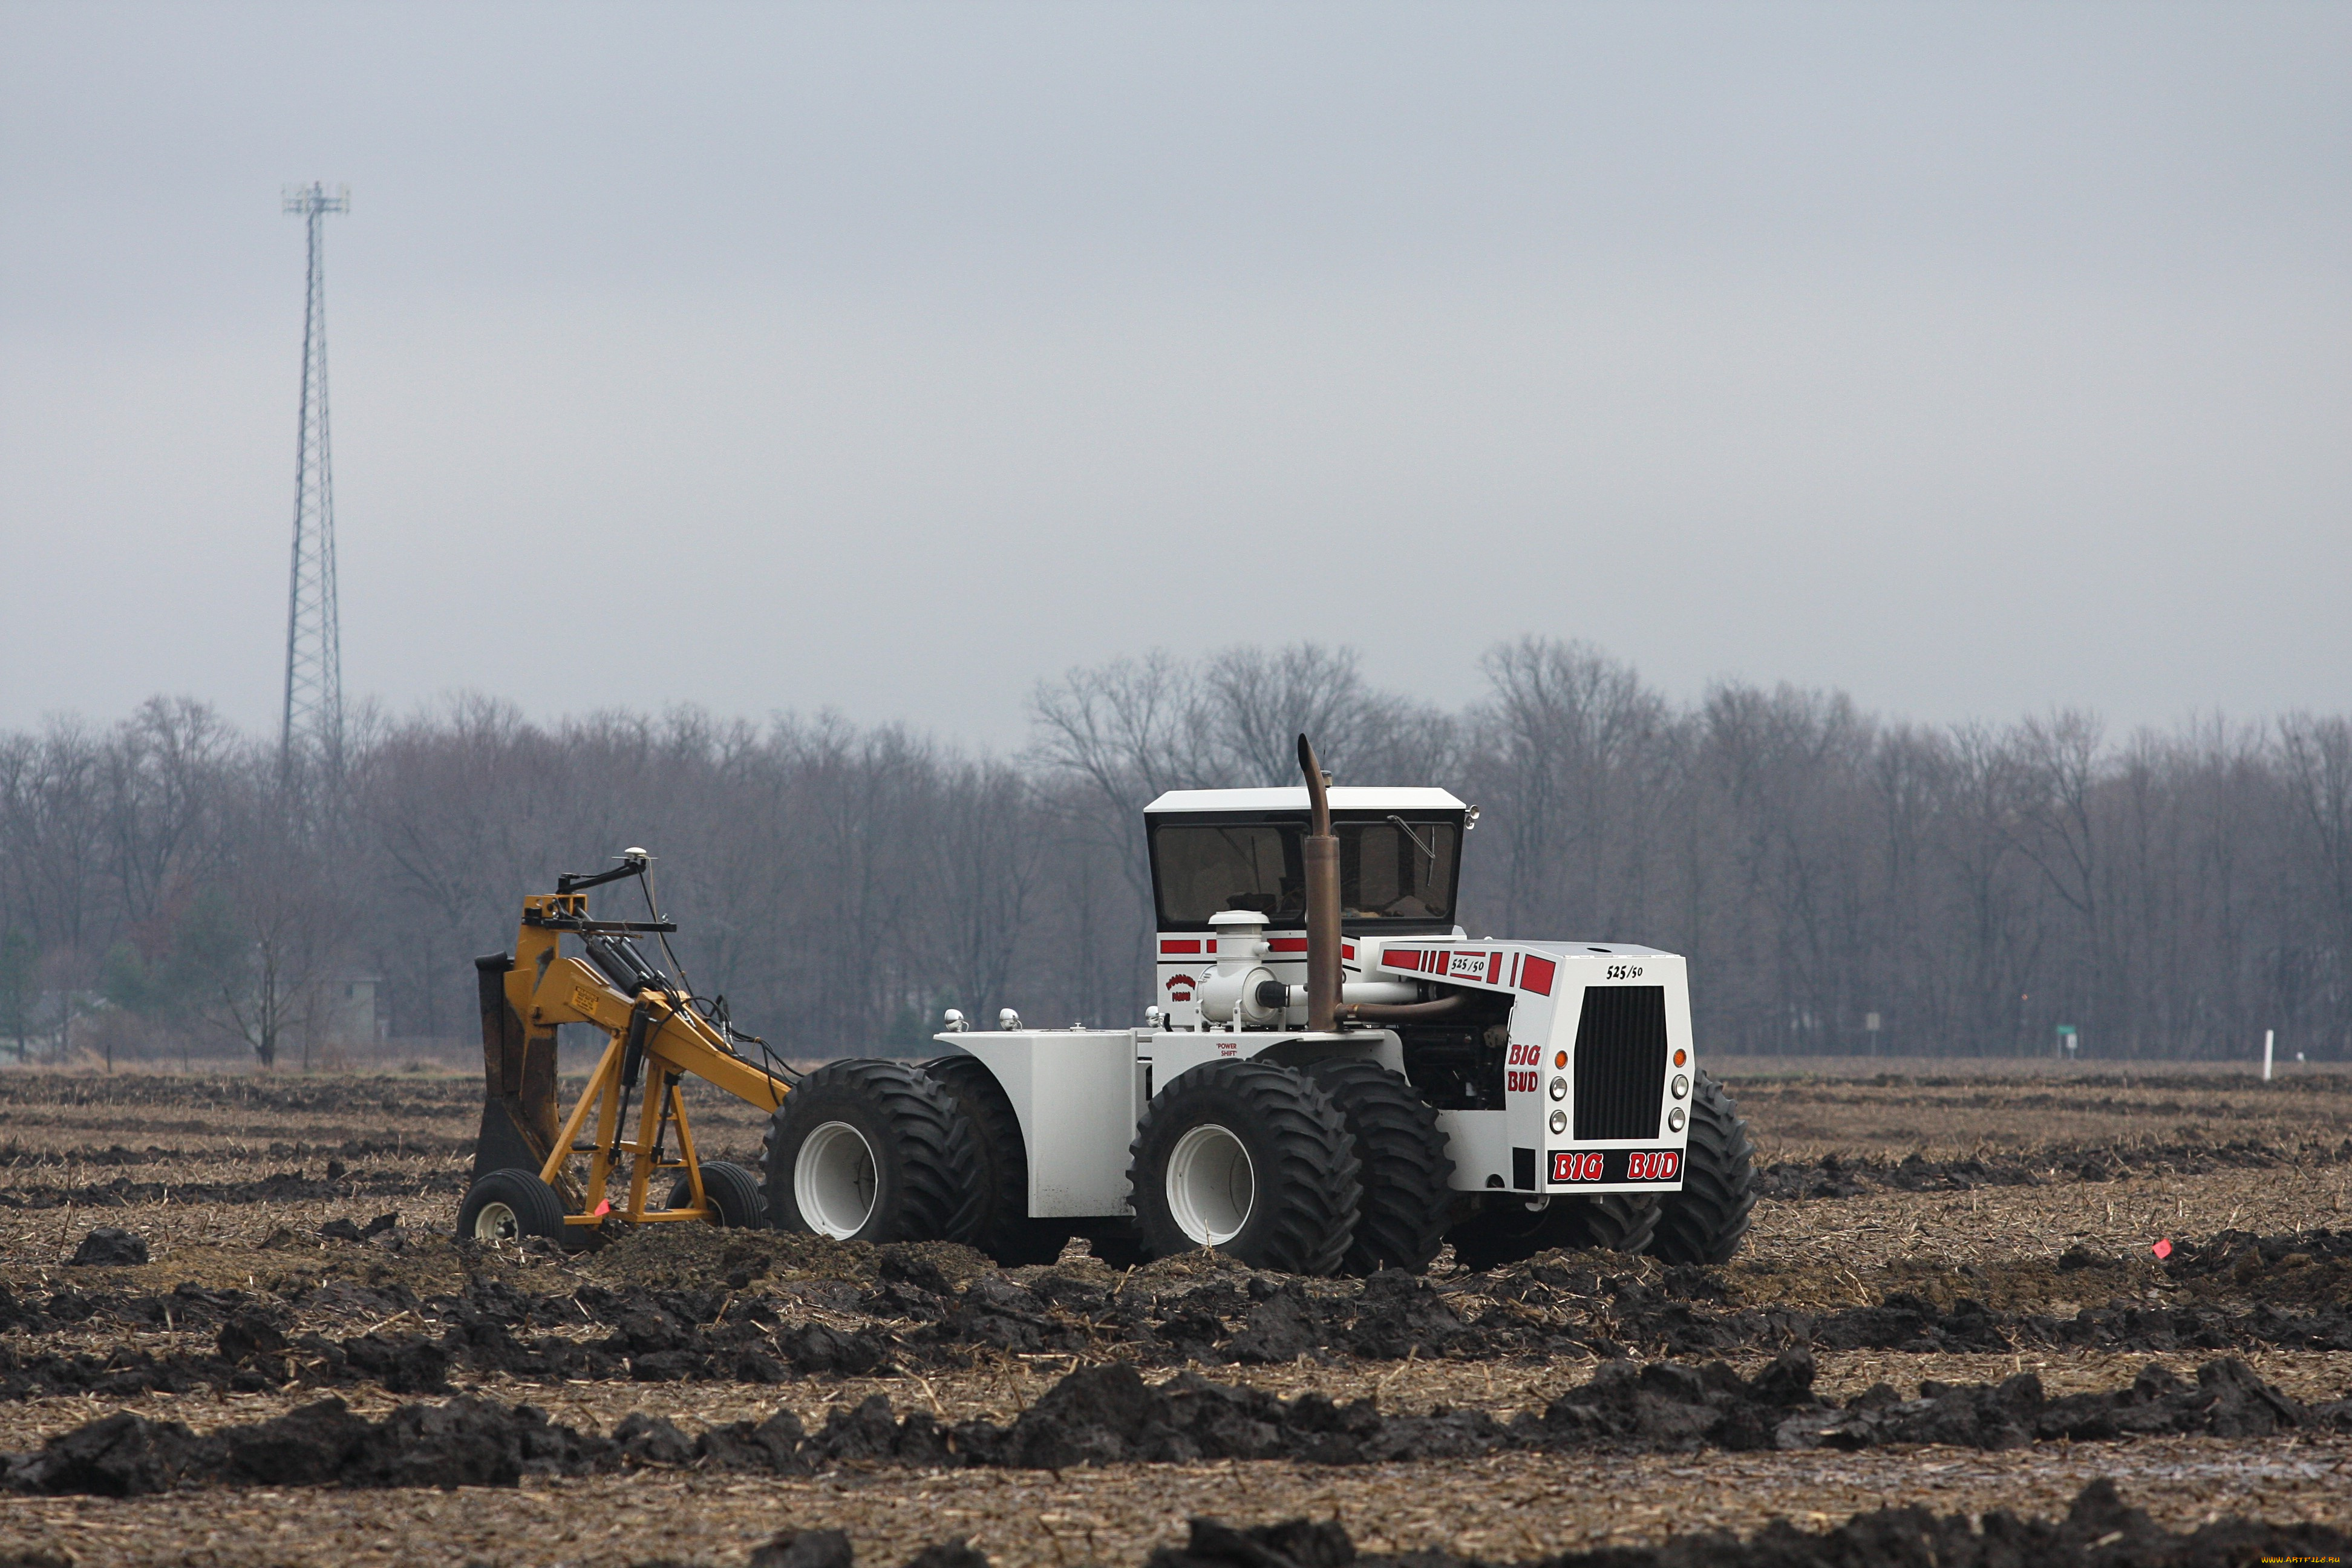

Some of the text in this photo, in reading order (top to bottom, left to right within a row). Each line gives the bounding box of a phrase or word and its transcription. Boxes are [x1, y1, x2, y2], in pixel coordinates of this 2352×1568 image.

[1451, 958, 1484, 972] 525/50
[1607, 965, 1643, 979] 525/50
[1508, 1044, 1541, 1066] BIG
[1508, 1071, 1538, 1093] BUD
[1553, 1152, 1679, 1180] BIG BUD
